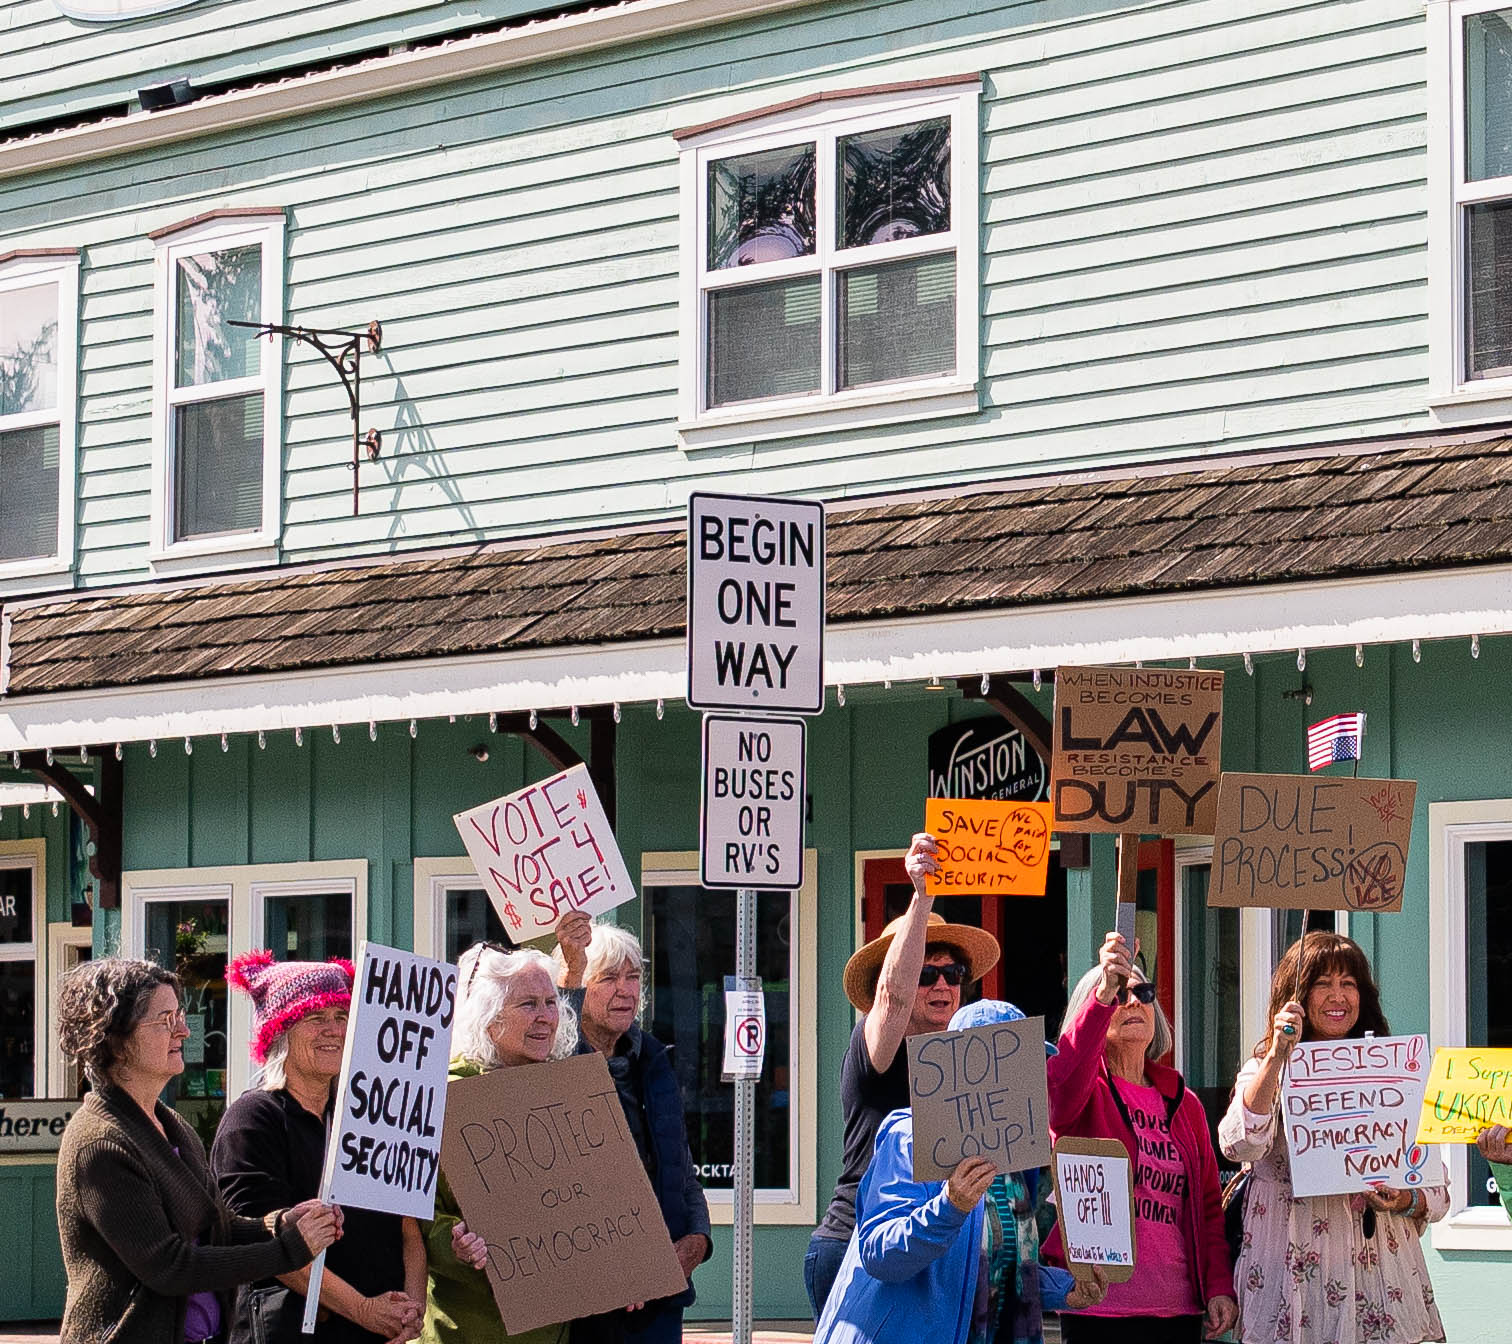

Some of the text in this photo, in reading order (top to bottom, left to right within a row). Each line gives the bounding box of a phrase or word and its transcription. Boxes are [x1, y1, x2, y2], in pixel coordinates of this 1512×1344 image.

[700, 514, 815, 569] BEGIN
[718, 578, 797, 629] ONE
[715, 640, 799, 691] WAY
[1062, 671, 1222, 691] WHEN INJUSTICE
[1080, 691, 1193, 706] BECOMES
[738, 732, 772, 762] NO
[1062, 707, 1220, 756] LAW
[930, 729, 1025, 799] WINSTON
[1068, 753, 1208, 766] RESISTANCE
[1073, 765, 1184, 777] BECOMES
[714, 768, 795, 801] BUSES
[991, 773, 1040, 800] GENERAL
[1055, 779, 1216, 826] DUTY
[470, 774, 576, 856] VOTE
[738, 806, 771, 838] OR
[938, 811, 999, 837] SAVE
[1240, 784, 1343, 835] DUE
[489, 822, 604, 898] NOT 4
[725, 843, 780, 875] RV'S
[935, 839, 1009, 864] SOCIAL
[1220, 824, 1355, 898] PROCESS!
[530, 865, 615, 926] SALE!
[934, 869, 1017, 887] SECURITY
[365, 957, 456, 1029] HANDS
[378, 1017, 435, 1070] OFF
[913, 1029, 1021, 1097] STOP
[1290, 1036, 1423, 1078] RESIST!
[1446, 1058, 1451, 1080] I
[350, 1071, 435, 1137] SOCIAL
[944, 1088, 1008, 1133] THE
[1288, 1088, 1404, 1117] DEFEND
[460, 1090, 624, 1194] PROTECT
[933, 1097, 1036, 1169] COUP!
[1292, 1119, 1408, 1155] DEMOCRACY
[341, 1132, 439, 1196] SECURITY
[1064, 1164, 1105, 1195] HANDS
[541, 1183, 591, 1208] OUR
[486, 1207, 645, 1281] DEMOCRACY
